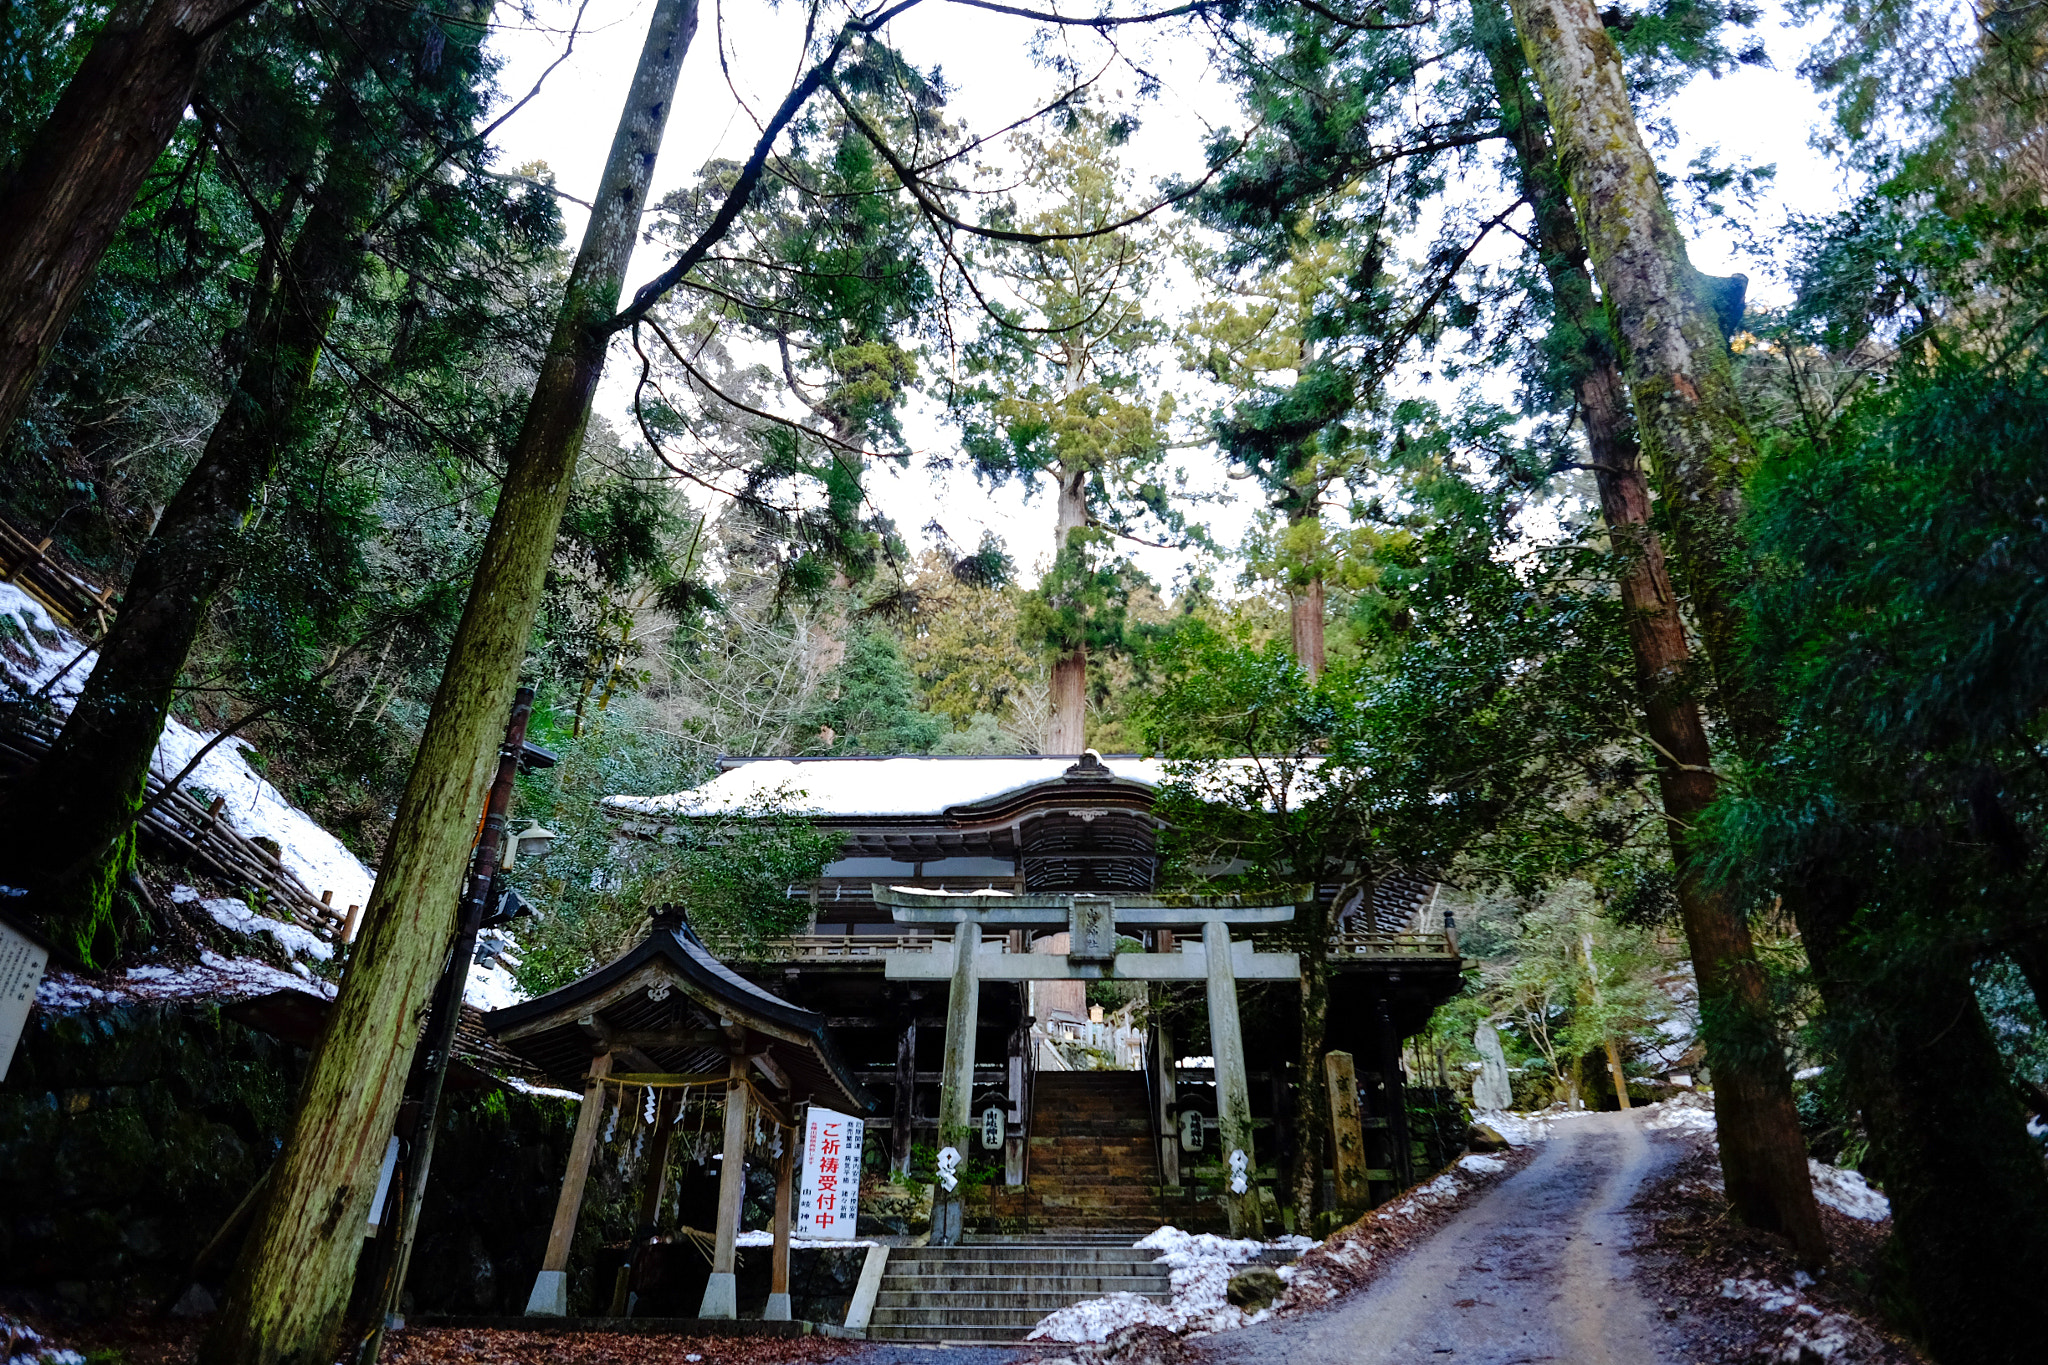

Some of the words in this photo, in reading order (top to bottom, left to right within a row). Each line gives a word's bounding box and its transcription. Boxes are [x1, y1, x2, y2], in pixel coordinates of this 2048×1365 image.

[816, 1122, 842, 1229] ご祈祷受付中
